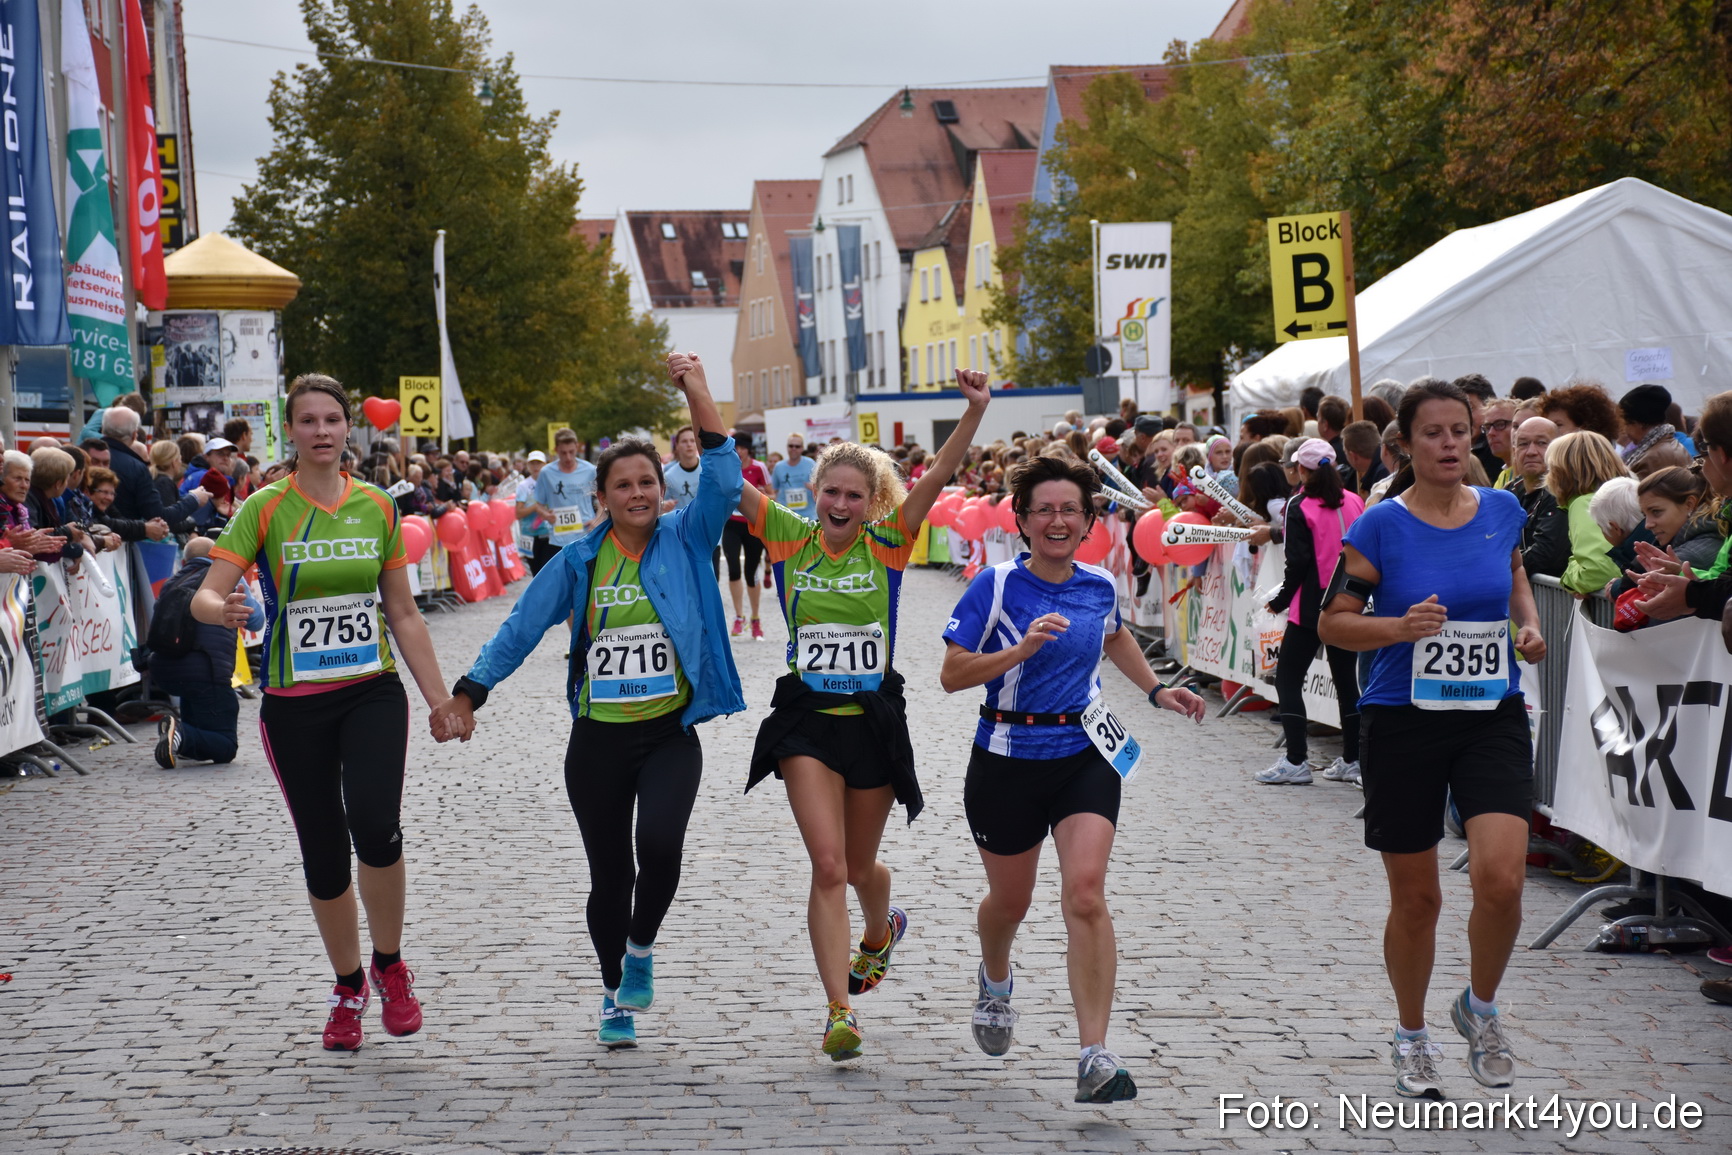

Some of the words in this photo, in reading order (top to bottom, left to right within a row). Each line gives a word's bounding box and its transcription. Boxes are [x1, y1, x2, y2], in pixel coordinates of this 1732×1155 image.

[1278, 218, 1342, 245] Block
[1105, 252, 1167, 270] swn
[1292, 252, 1335, 313] B
[404, 379, 435, 391] Block
[410, 394, 430, 423] C
[863, 421, 875, 437] D
[1207, 480, 1230, 501] BMW
[559, 513, 577, 525] 150
[282, 538, 379, 565] BOCK
[793, 569, 879, 593] BOCK
[289, 605, 321, 616] PARTL
[322, 601, 362, 613] Neumarkt
[298, 612, 373, 649] 2753
[617, 631, 659, 642] Neumarkt
[799, 631, 826, 640] PARTL
[827, 630, 870, 639] Neumarkt
[1453, 630, 1496, 640] Neumarkt
[318, 653, 359, 667] Annika
[595, 642, 668, 677] 2716
[807, 640, 878, 671] 2710
[1424, 641, 1500, 677] 2359
[618, 683, 648, 696] Alice
[823, 678, 862, 690] Kerstin
[1441, 684, 1485, 698] Melitta
[1083, 707, 1103, 729] PARTL
